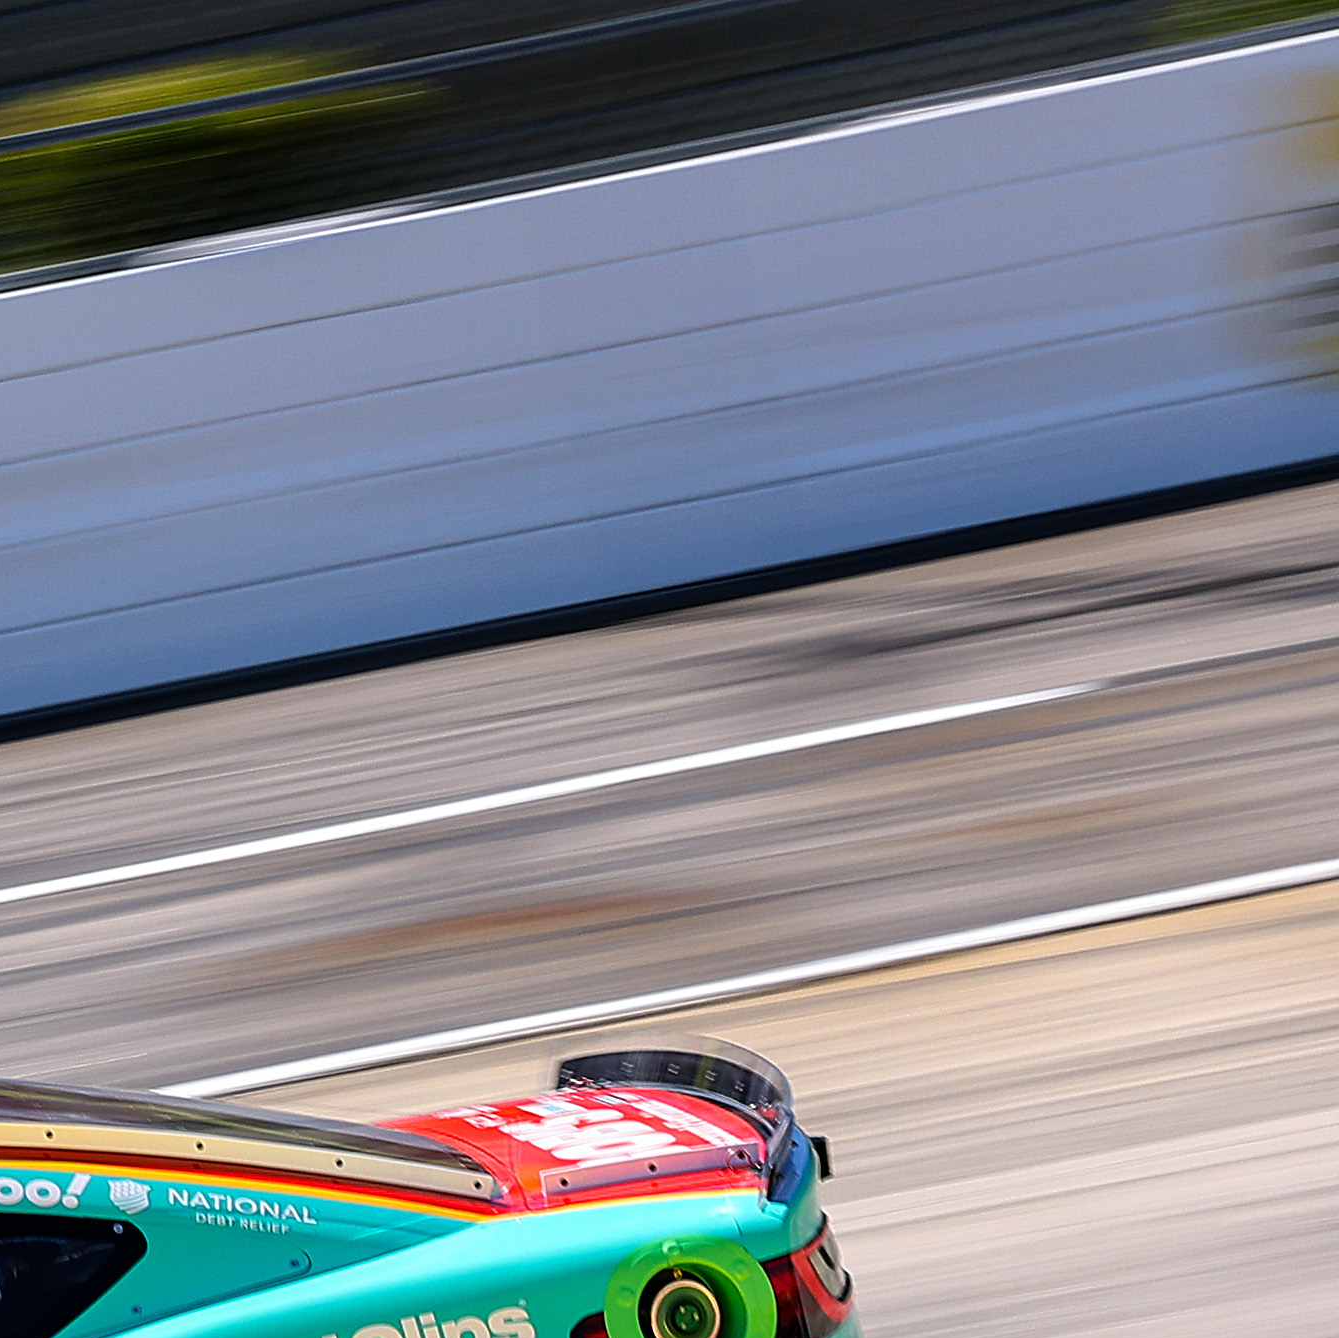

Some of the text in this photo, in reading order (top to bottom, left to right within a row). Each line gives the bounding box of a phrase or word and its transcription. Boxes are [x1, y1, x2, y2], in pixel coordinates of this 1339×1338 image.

[167, 1187, 318, 1225] NATIONAL
[195, 1212, 291, 1235] DEBT RELIEF
